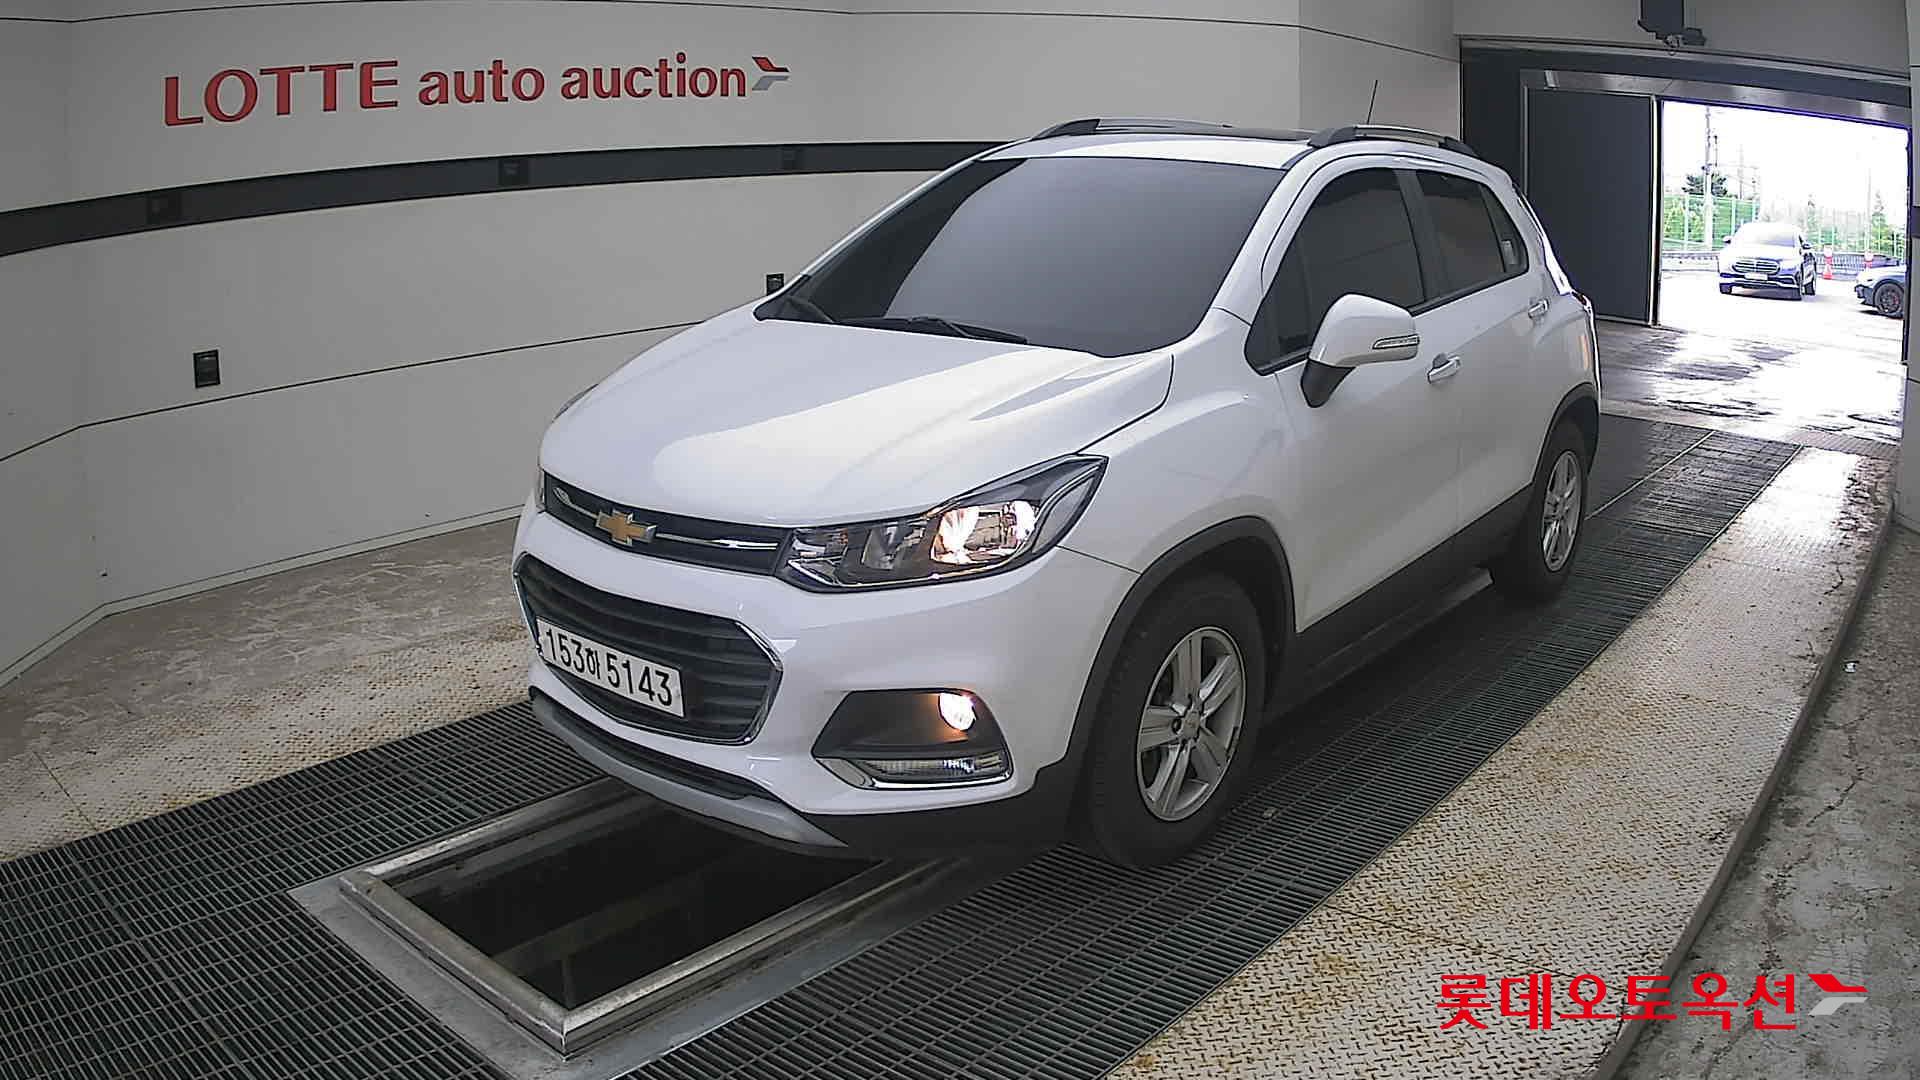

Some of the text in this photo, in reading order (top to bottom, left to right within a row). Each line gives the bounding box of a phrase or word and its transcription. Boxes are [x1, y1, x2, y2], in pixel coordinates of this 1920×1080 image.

[164, 52, 747, 126] LOTTE auto auction
[606, 651, 673, 707] 5143
